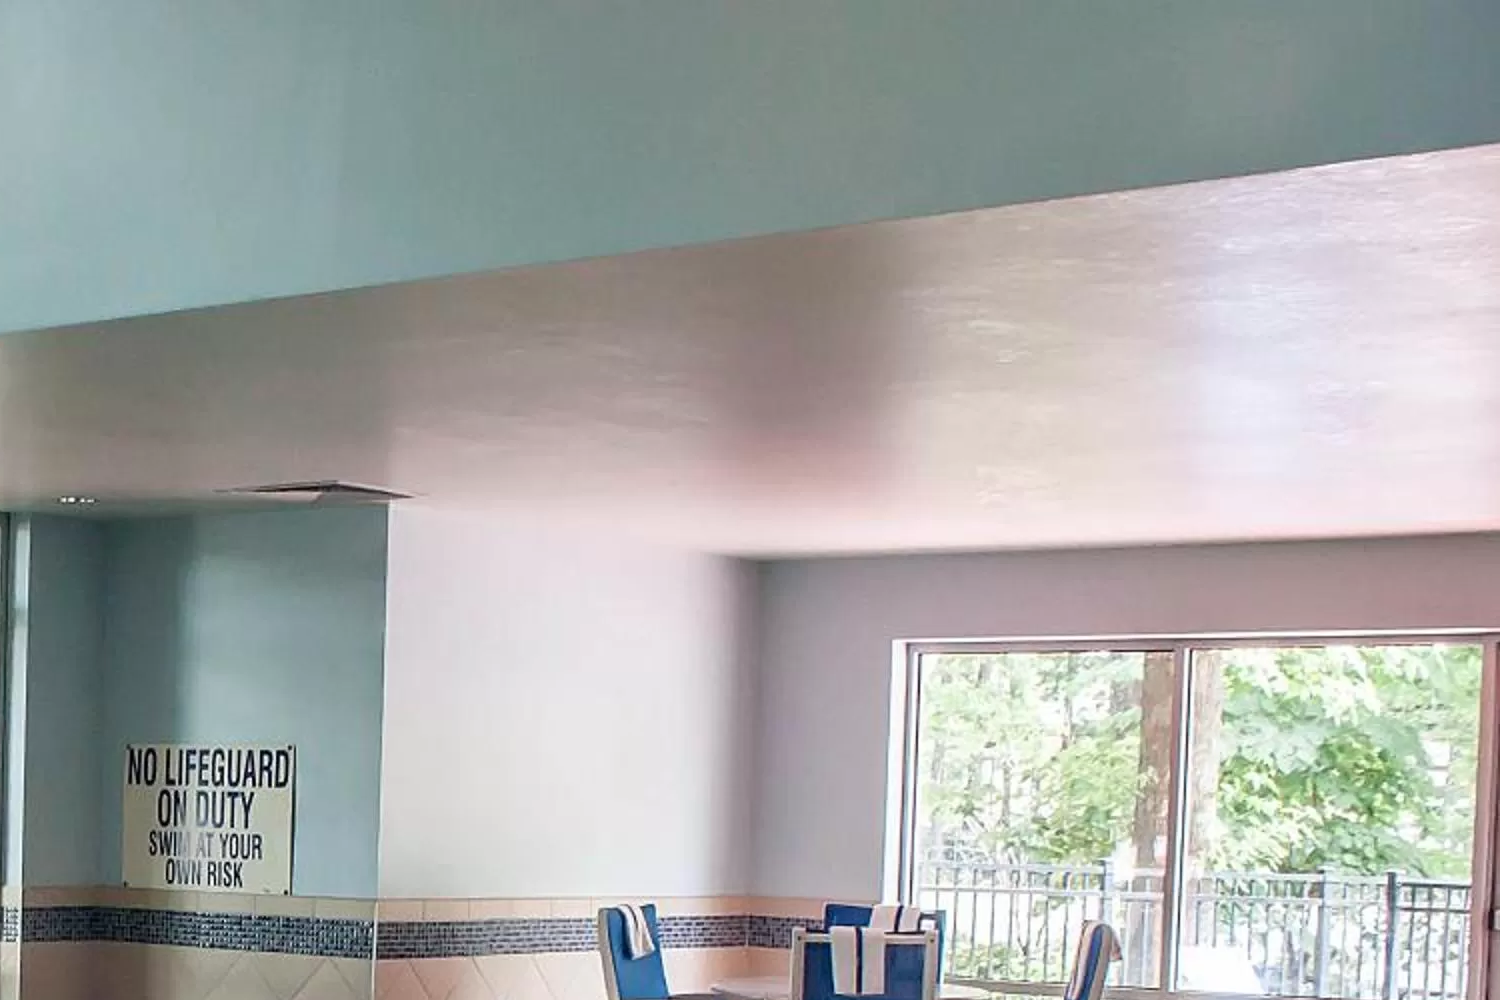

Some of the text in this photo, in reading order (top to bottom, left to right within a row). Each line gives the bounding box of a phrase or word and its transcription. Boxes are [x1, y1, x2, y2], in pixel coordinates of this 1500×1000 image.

[127, 747, 290, 789] NO LIFEGUARD
[157, 789, 255, 829] ON DUTY
[149, 830, 263, 860] SWIM AT YOUR
[165, 858, 244, 888] OWN RISK
